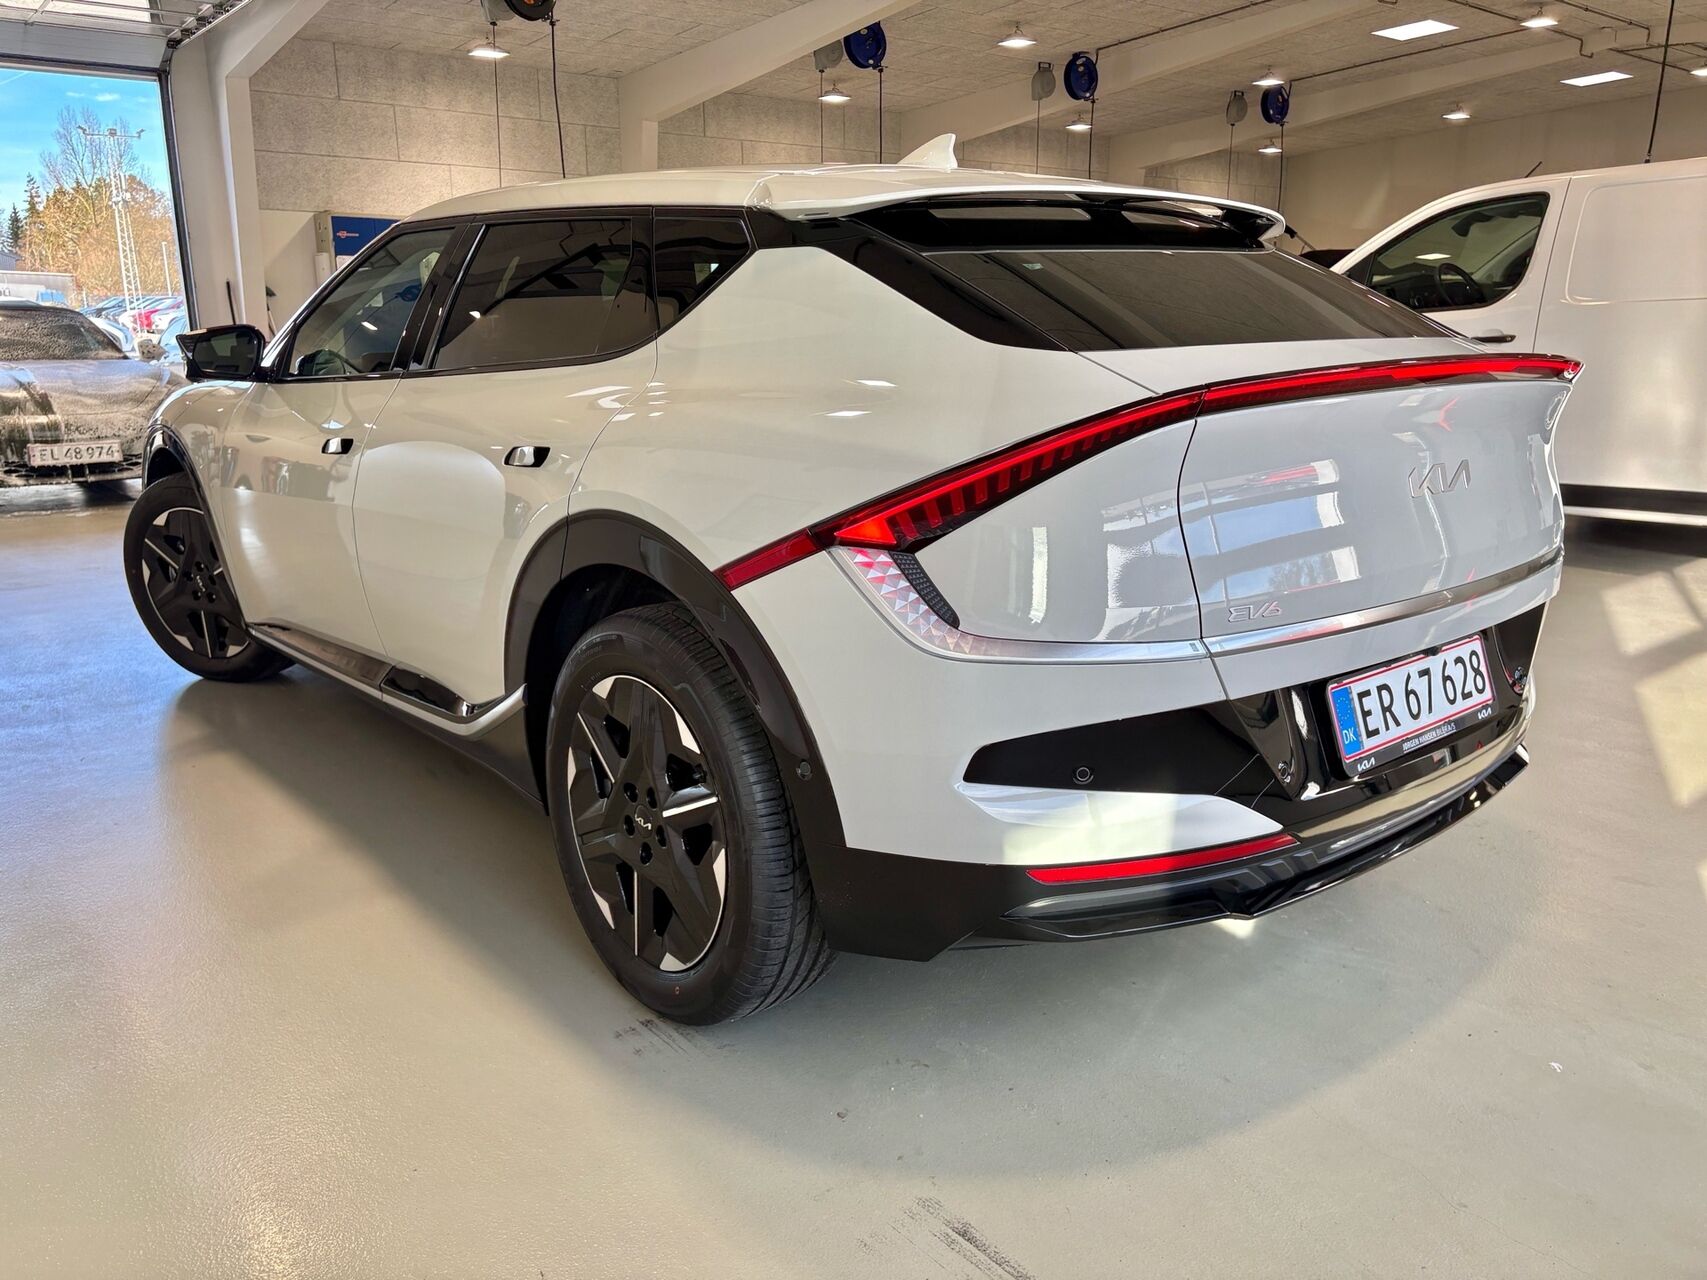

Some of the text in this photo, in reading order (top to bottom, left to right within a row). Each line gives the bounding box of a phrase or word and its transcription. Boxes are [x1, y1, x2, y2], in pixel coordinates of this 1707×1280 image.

[39, 445, 115, 461] EL 48 974
[1408, 459, 1472, 499] KIA
[1228, 601, 1282, 623] EV6
[1357, 649, 1486, 739] ER 67 628
[1477, 707, 1492, 720] KIA
[1342, 728, 1357, 744] DK
[1419, 730, 1437, 744] HANSEN
[1357, 756, 1376, 771] KIA
